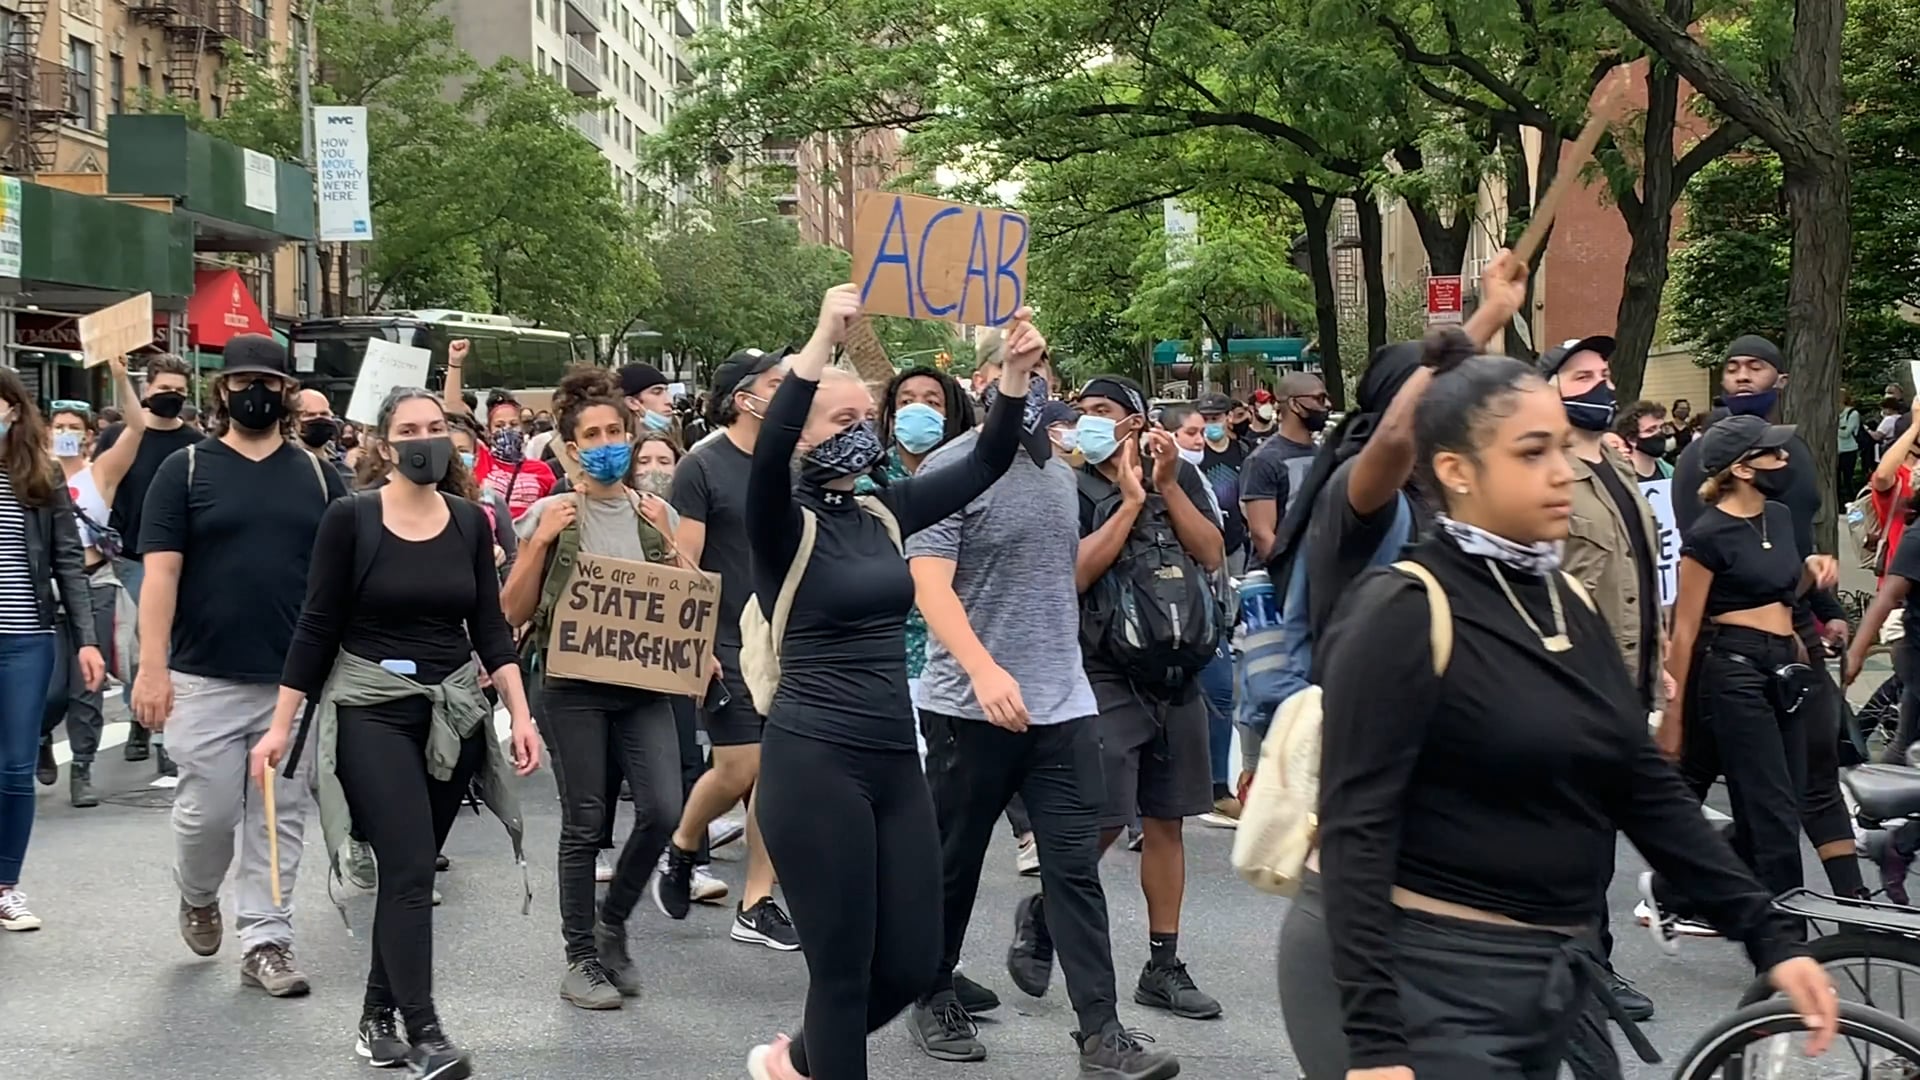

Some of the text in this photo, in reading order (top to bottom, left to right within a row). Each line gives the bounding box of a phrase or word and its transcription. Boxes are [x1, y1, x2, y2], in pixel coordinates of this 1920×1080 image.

[328, 116, 353, 125] NYC
[321, 138, 348, 148] HOW
[321, 149, 345, 158] YOU
[322, 160, 355, 169] MOVE
[322, 170, 363, 180] IS WHY
[323, 181, 359, 190] WE'RE
[324, 191, 358, 201] HERE.
[861, 196, 1028, 326] ACAB
[577, 560, 604, 580] We
[611, 569, 635, 585] are
[647, 572, 660, 588] in
[669, 579, 680, 591] a
[569, 581, 713, 632] STATE OF
[559, 621, 707, 678] EMERGENCY
